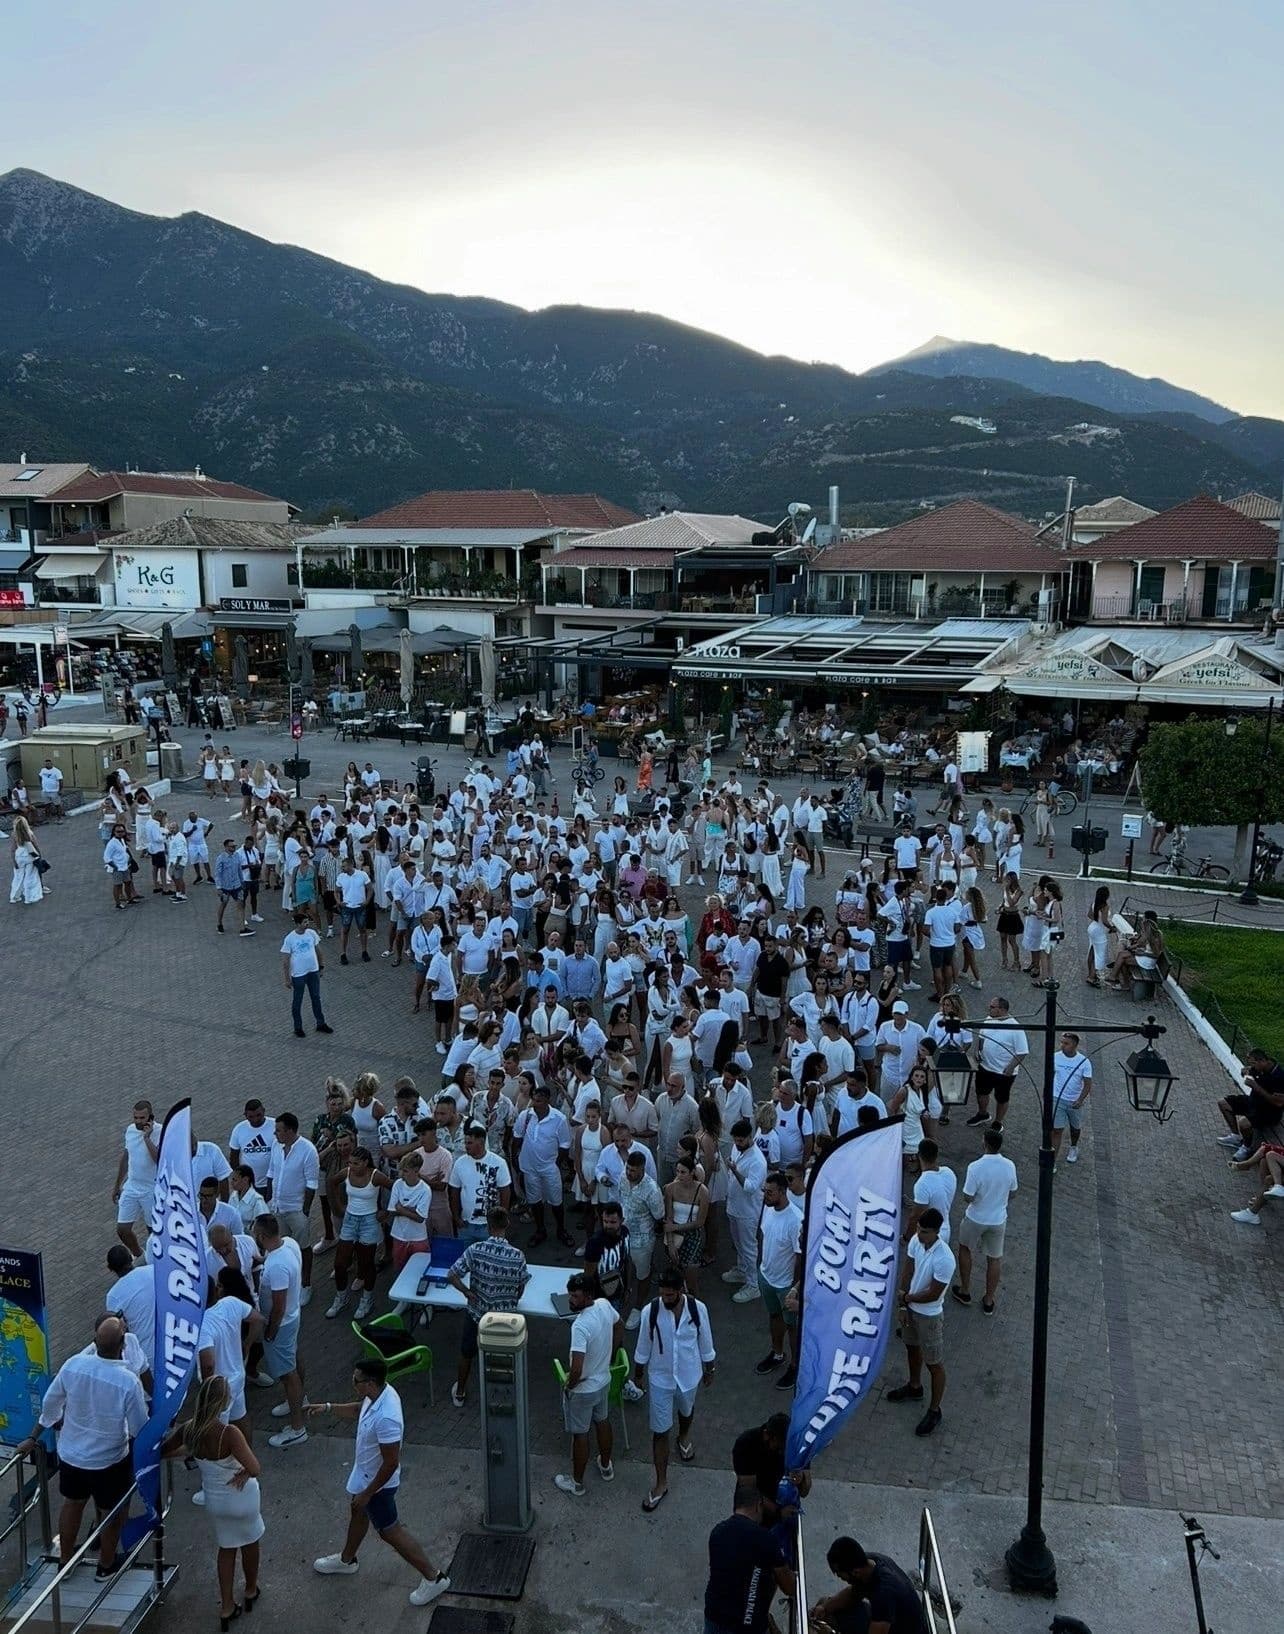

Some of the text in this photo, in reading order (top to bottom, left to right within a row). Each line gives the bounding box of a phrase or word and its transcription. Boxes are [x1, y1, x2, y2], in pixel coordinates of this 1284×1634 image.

[138, 566, 174, 586] K&G
[1196, 668, 1231, 678] yefsi
[813, 1186, 851, 1294] BOAT
[840, 1185, 897, 1338] PARTY
